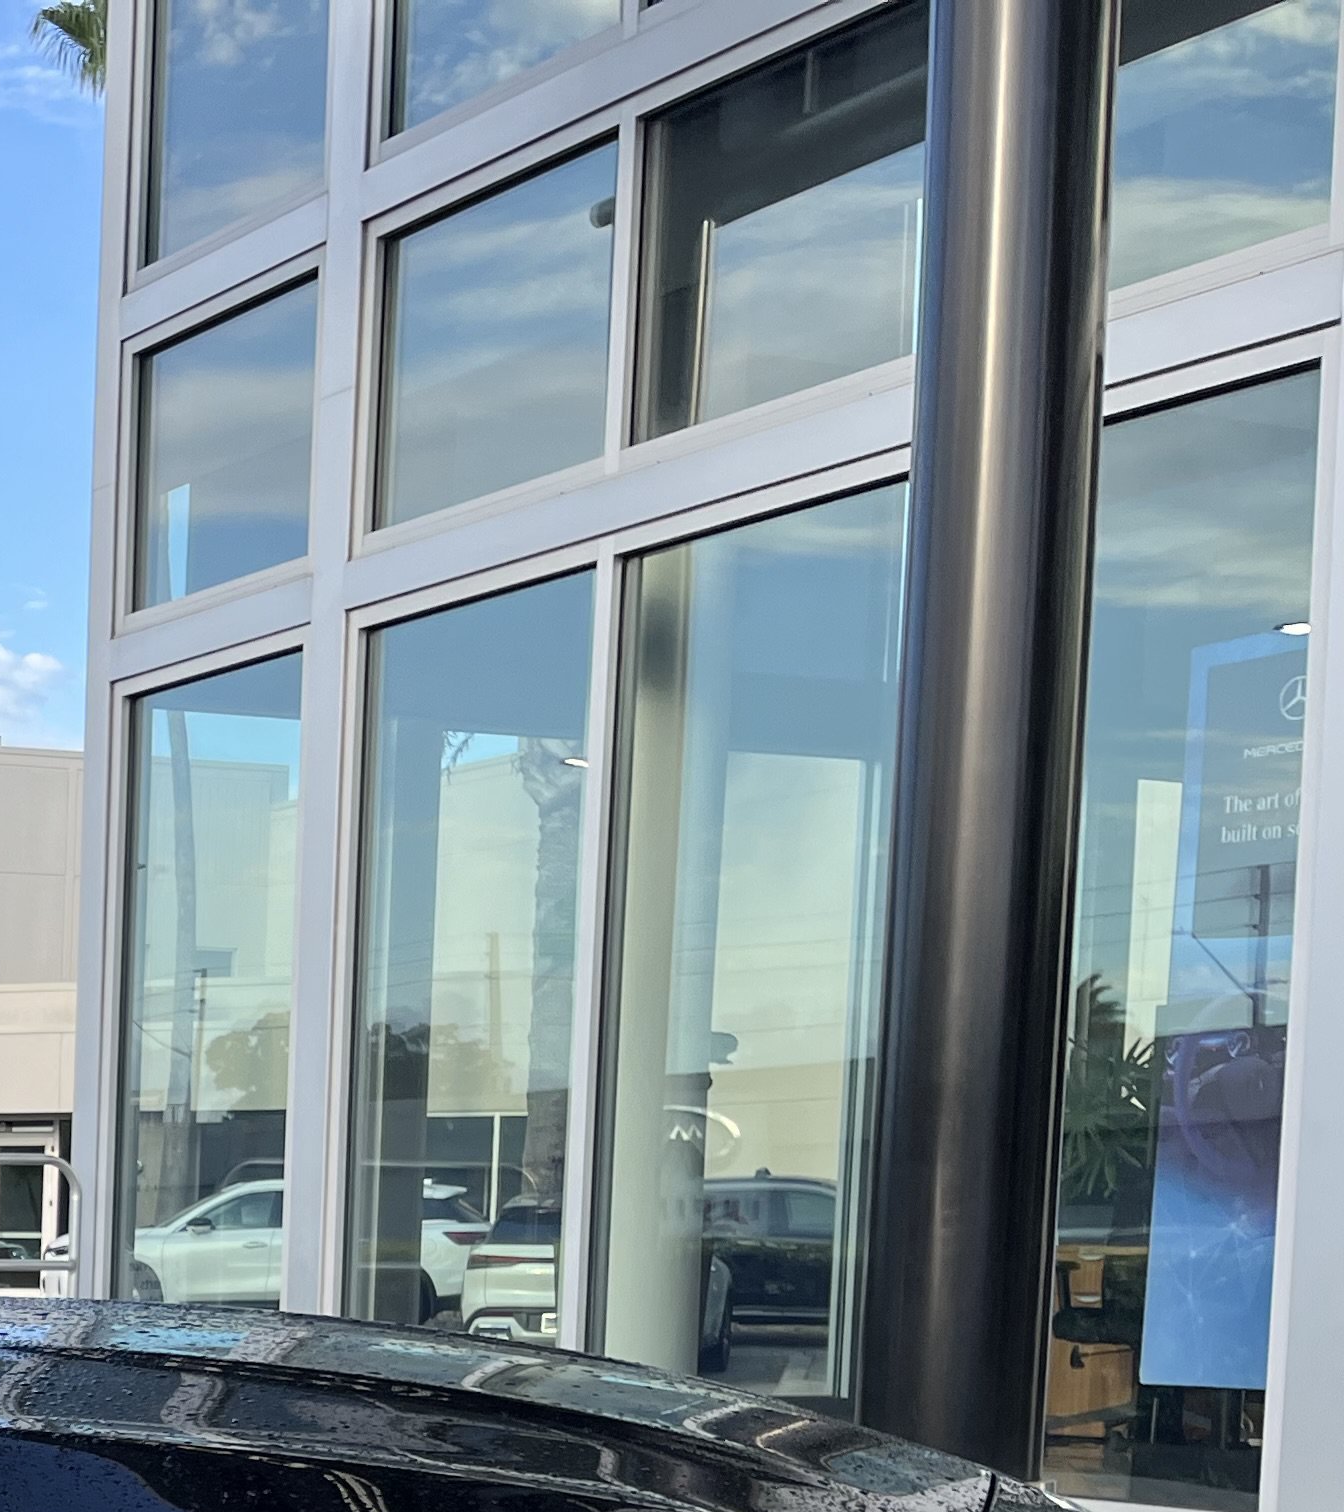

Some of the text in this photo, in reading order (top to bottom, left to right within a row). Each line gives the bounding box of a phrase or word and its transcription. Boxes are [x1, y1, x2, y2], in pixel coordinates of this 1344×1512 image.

[1224, 795, 1252, 814] The
[1256, 792, 1279, 811] art
[1221, 823, 1257, 844] built
[1262, 825, 1282, 840] on
